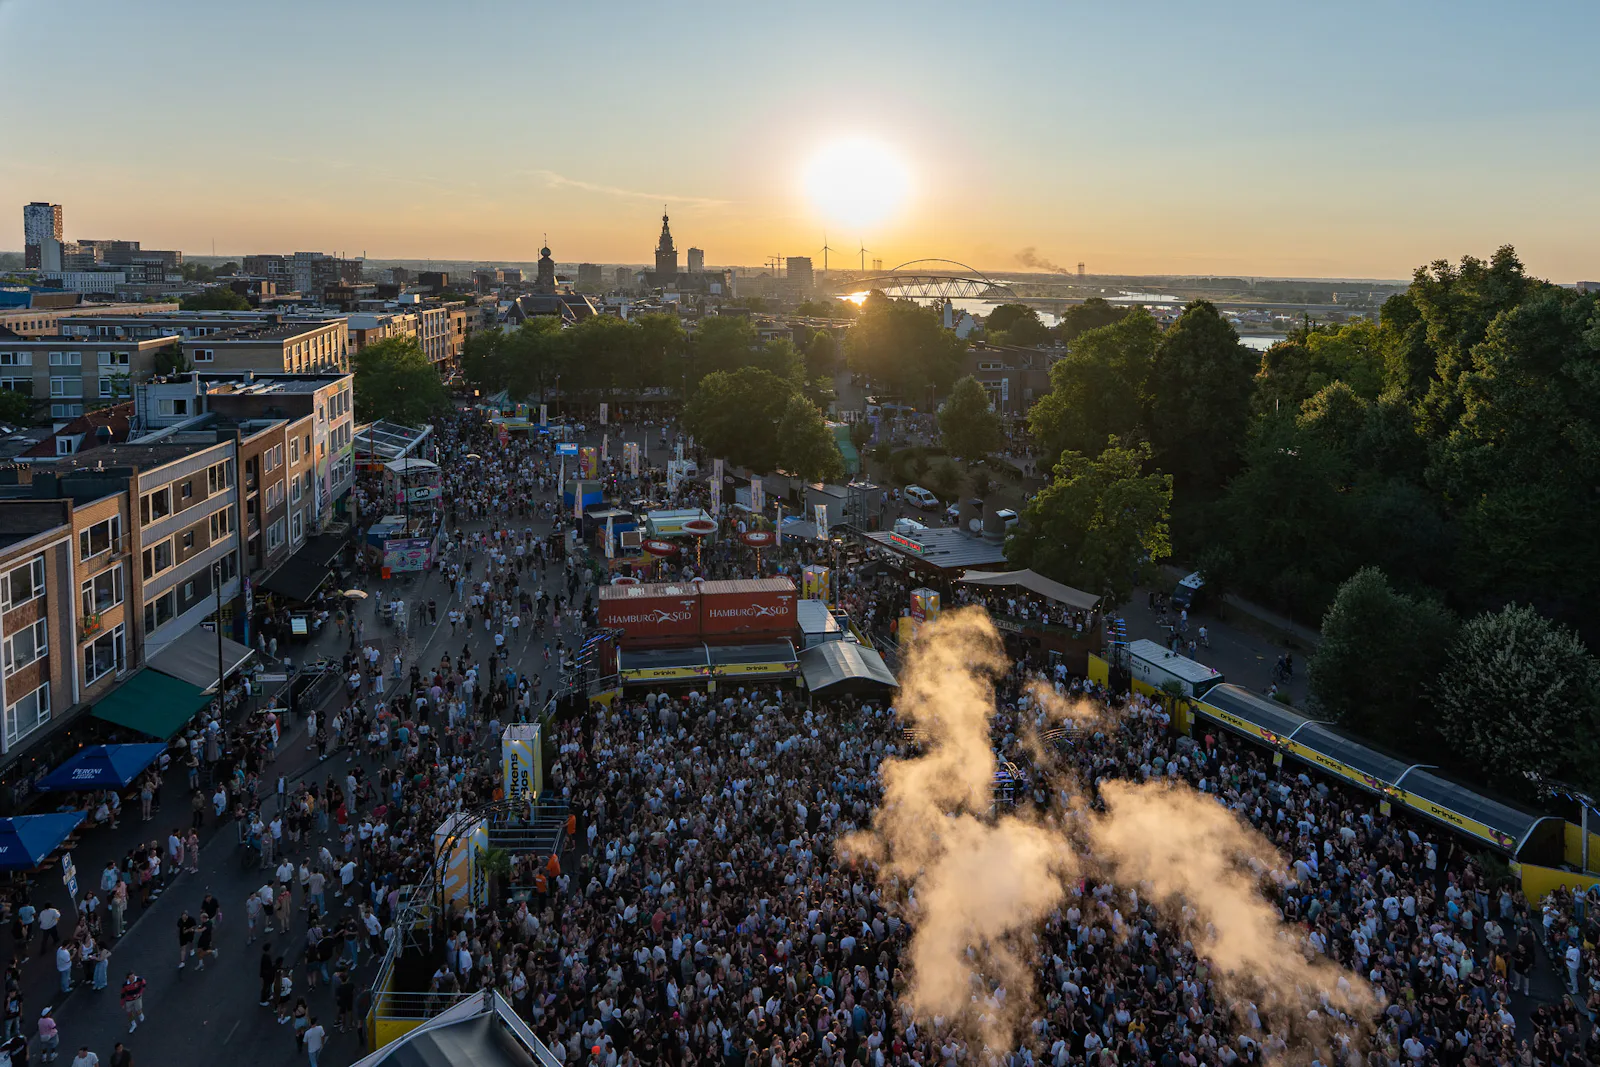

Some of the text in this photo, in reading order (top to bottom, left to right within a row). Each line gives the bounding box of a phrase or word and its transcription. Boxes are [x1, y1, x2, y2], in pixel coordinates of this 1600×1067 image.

[609, 611, 691, 624] HAMBURG SÜD
[710, 605, 789, 618] HAMBURG SÜD
[1220, 713, 1243, 727] Drinks
[1316, 755, 1342, 771] Drinks
[1431, 806, 1463, 825] Drinks
